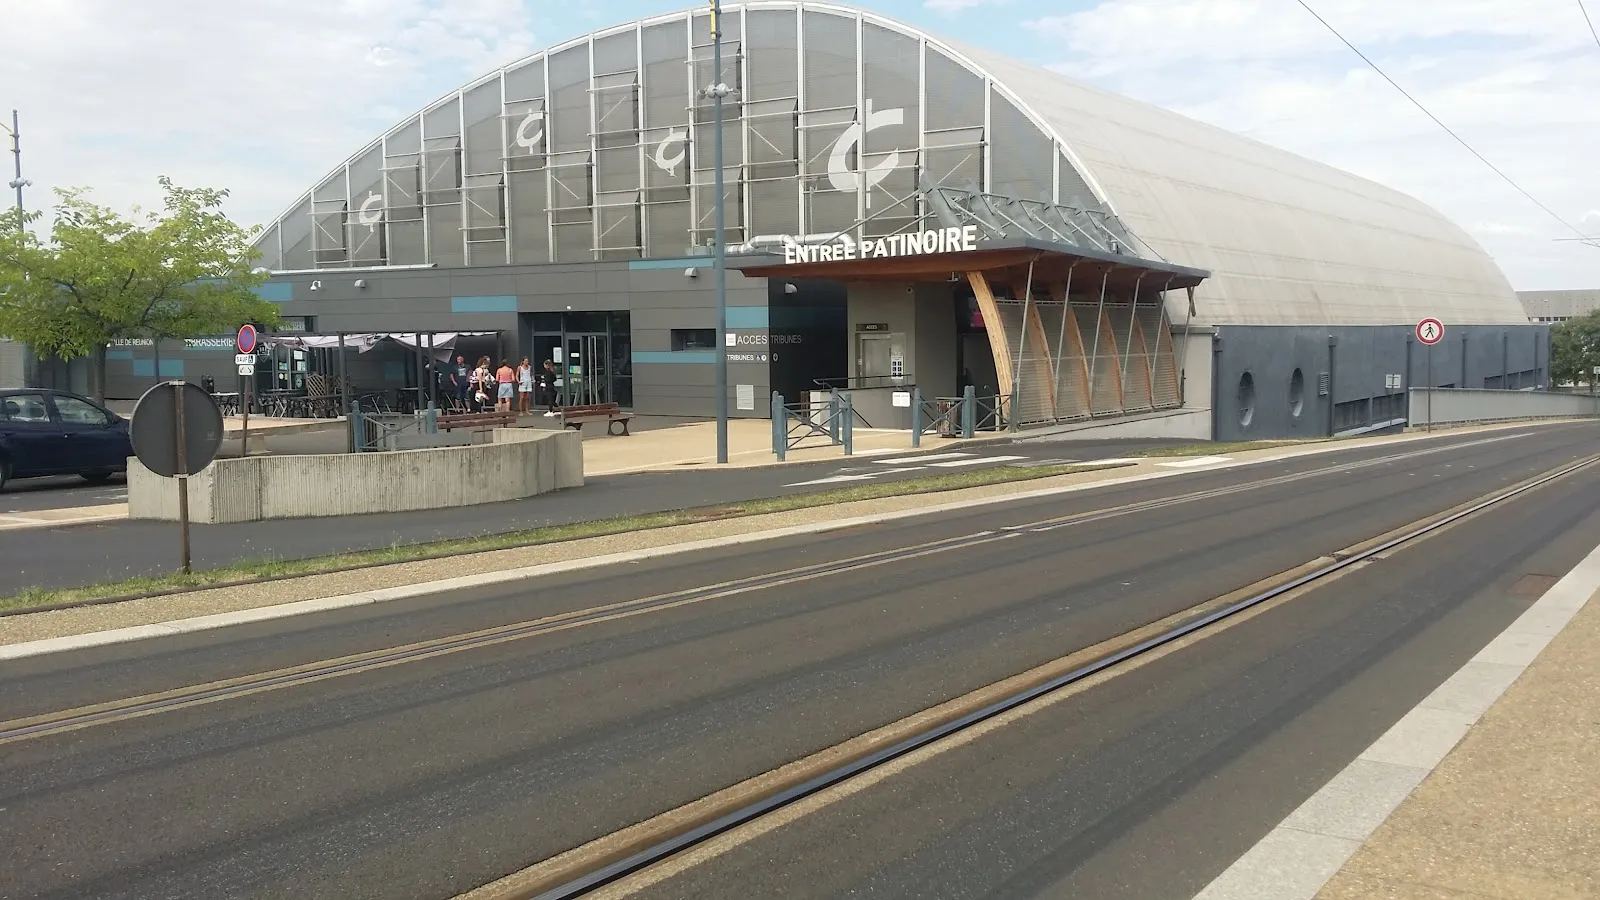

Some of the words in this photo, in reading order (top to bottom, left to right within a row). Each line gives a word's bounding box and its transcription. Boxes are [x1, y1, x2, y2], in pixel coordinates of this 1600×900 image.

[785, 242, 857, 265] ENTREE
[861, 225, 977, 259] PATINOIRE
[737, 335, 768, 345] ACCES
[771, 334, 802, 344] TRIBUNES
